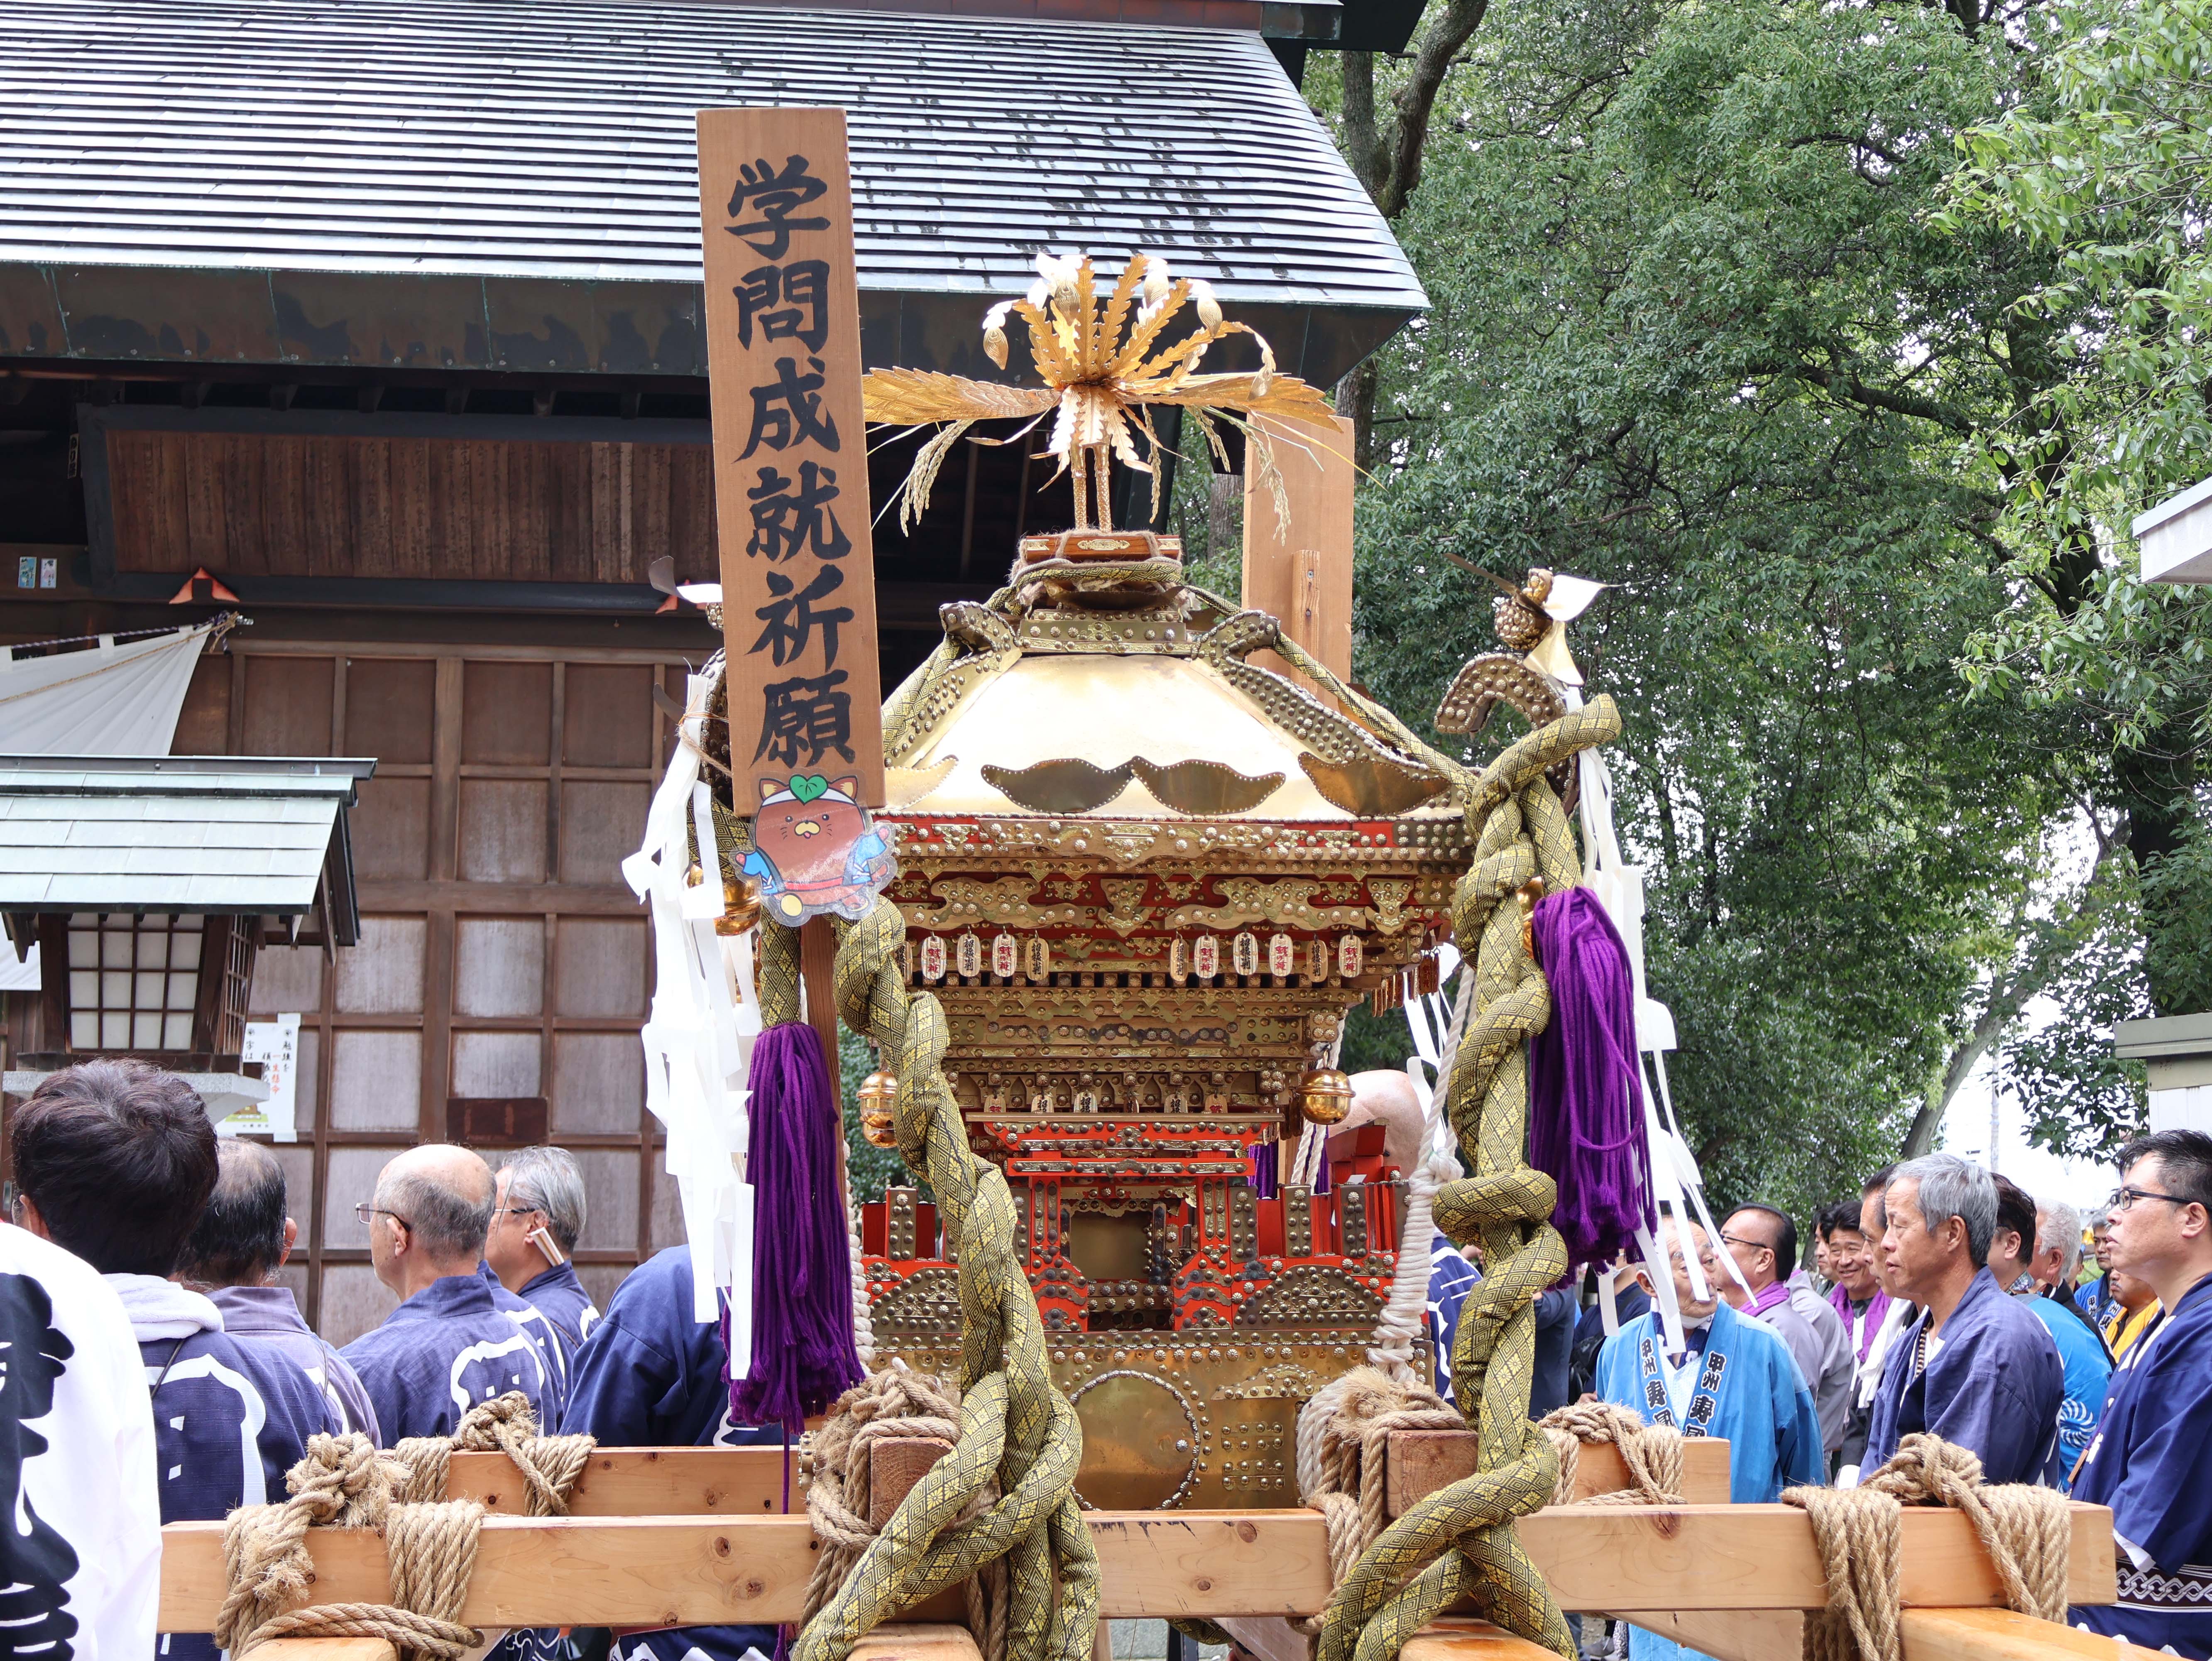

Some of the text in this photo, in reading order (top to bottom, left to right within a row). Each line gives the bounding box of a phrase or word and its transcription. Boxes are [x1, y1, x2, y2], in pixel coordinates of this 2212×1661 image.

[724, 154, 854, 769] 学問成就祈願
